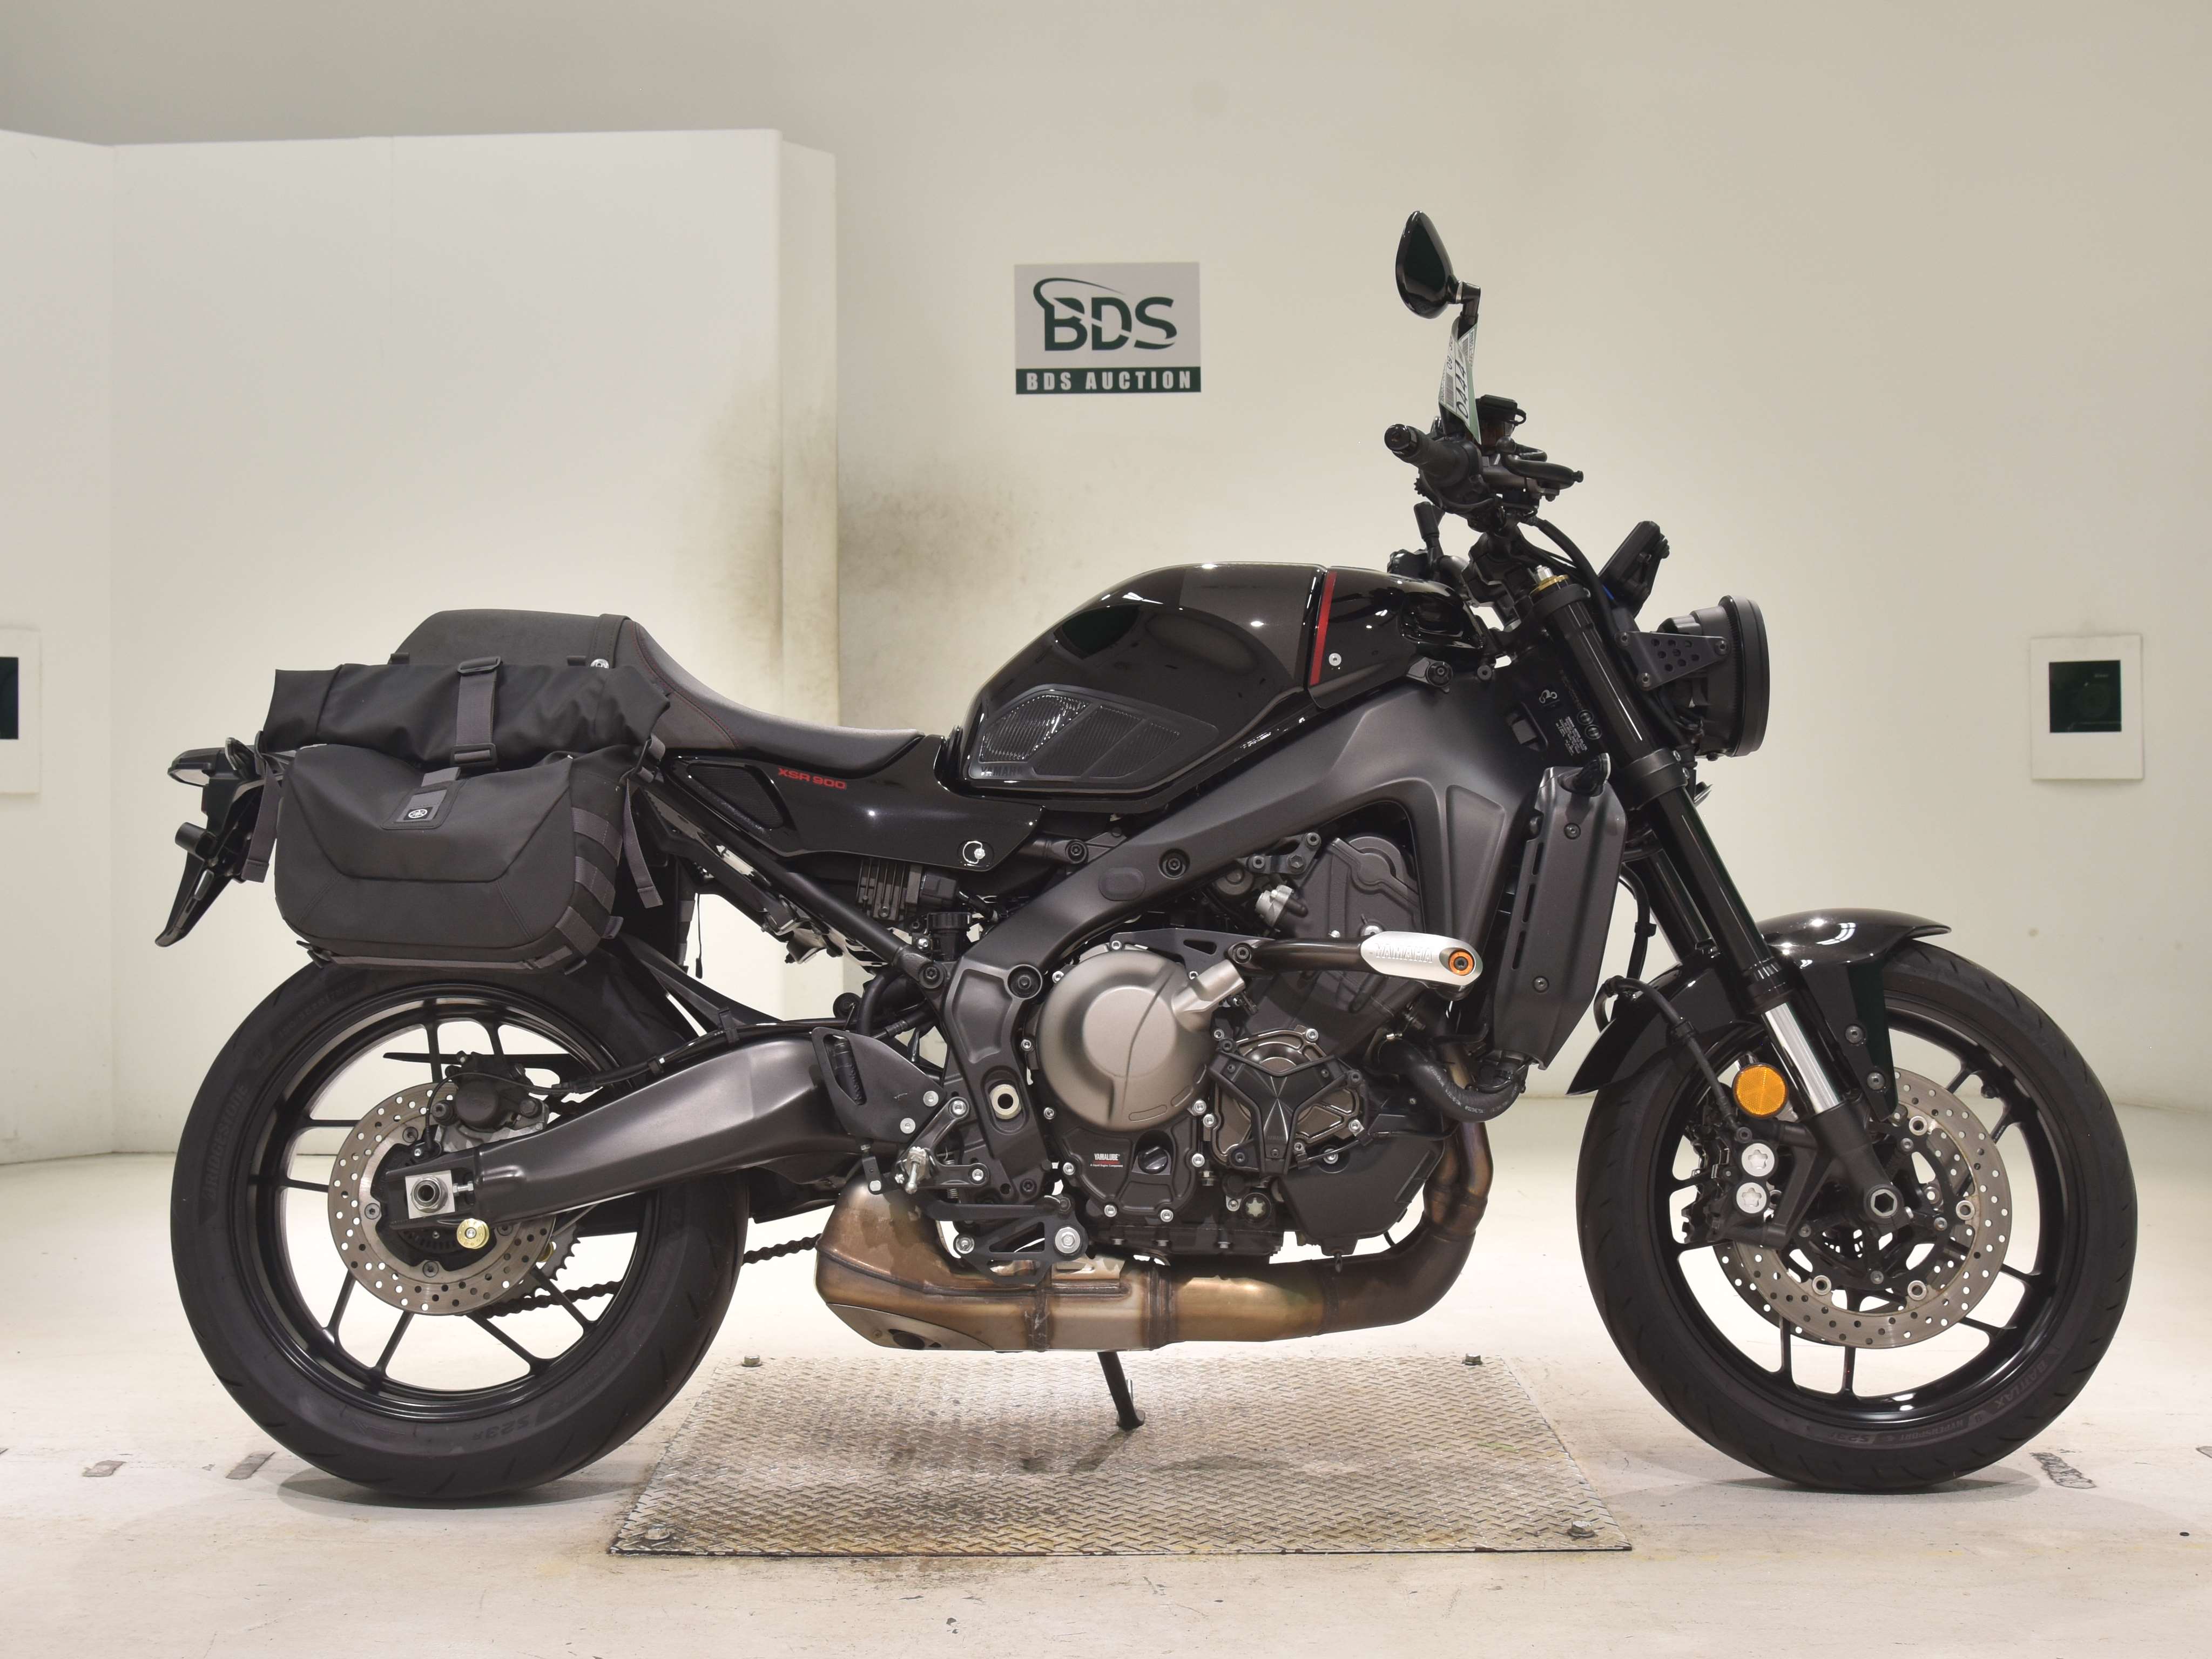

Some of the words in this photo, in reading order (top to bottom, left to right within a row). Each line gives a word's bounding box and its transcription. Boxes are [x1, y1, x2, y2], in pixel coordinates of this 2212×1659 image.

[1033, 277, 1177, 351] BDS
[1027, 373, 1071, 390] BDS
[1085, 371, 1191, 389] AUCTION
[778, 767, 811, 781] XSR
[813, 775, 846, 790] 900
[981, 766, 1023, 777] YAMAHA
[1375, 943, 1433, 963] YAMAHA
